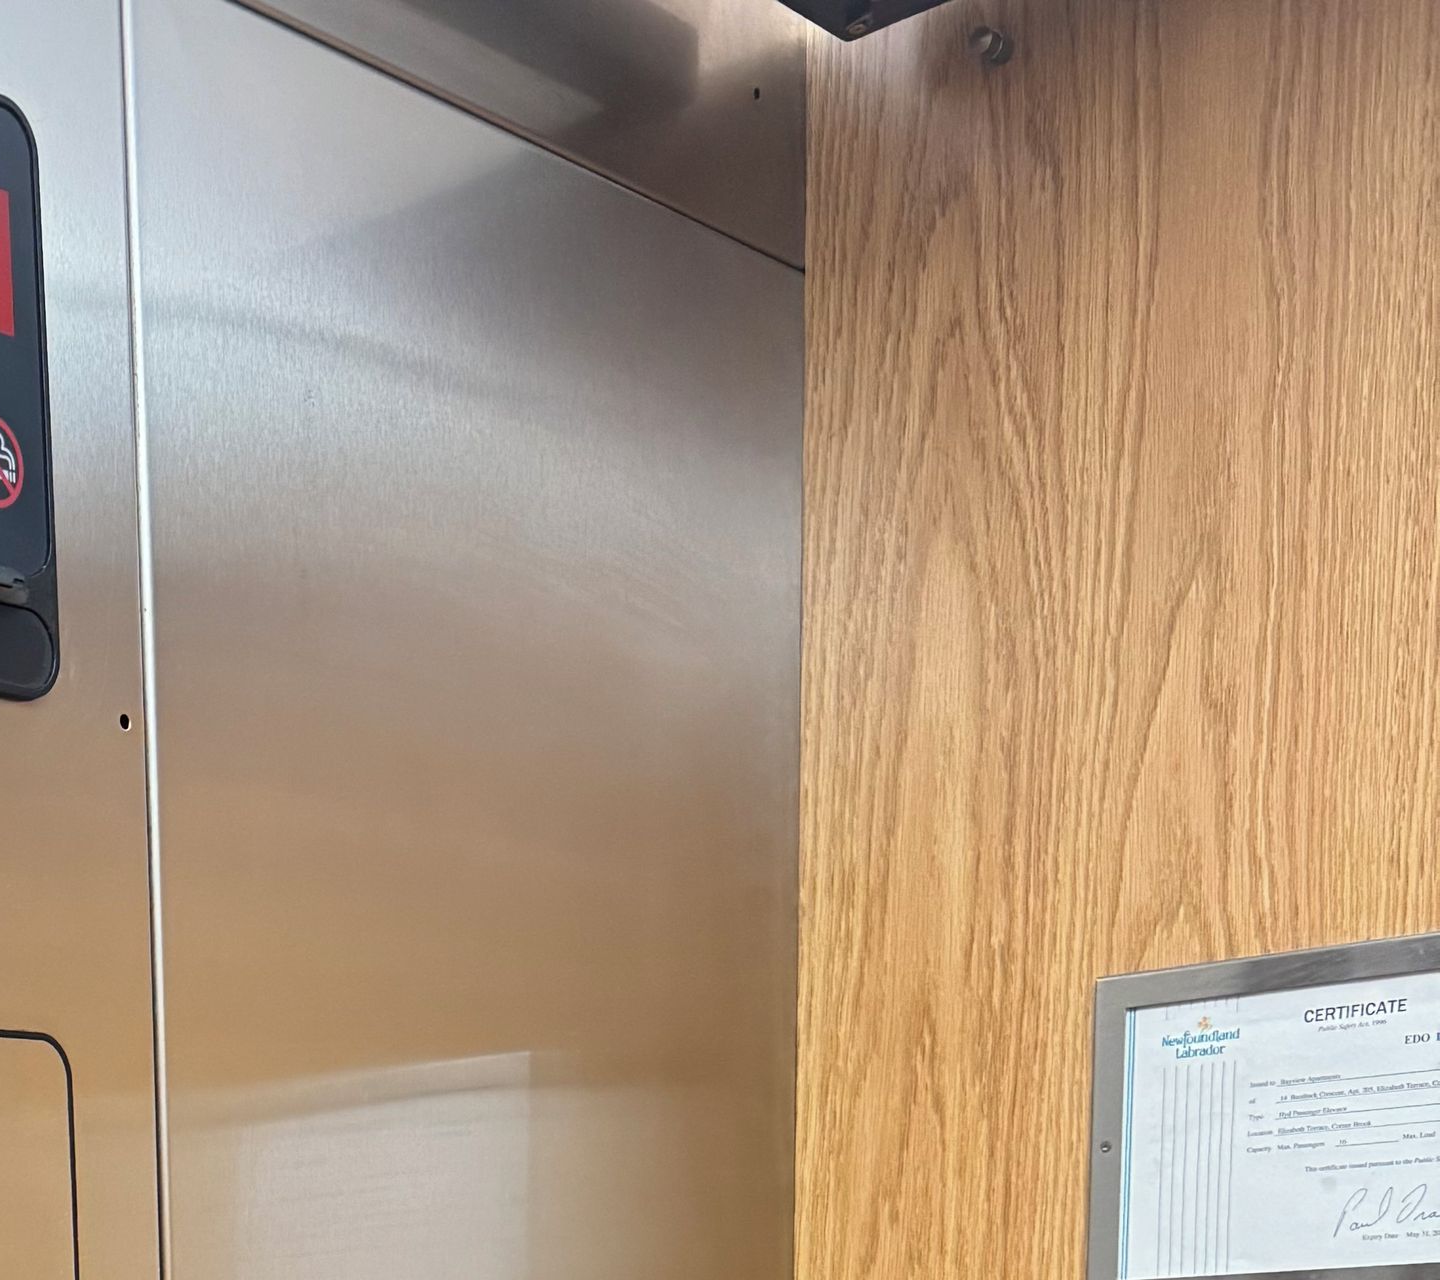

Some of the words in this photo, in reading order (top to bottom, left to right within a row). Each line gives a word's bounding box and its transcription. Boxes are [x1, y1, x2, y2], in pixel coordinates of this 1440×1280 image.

[1304, 998, 1408, 1023] CERTIFICATE
[1161, 1028, 1240, 1048] Newfoundland
[1404, 1033, 1431, 1045] EDO
[1176, 1044, 1226, 1059] Labrador
